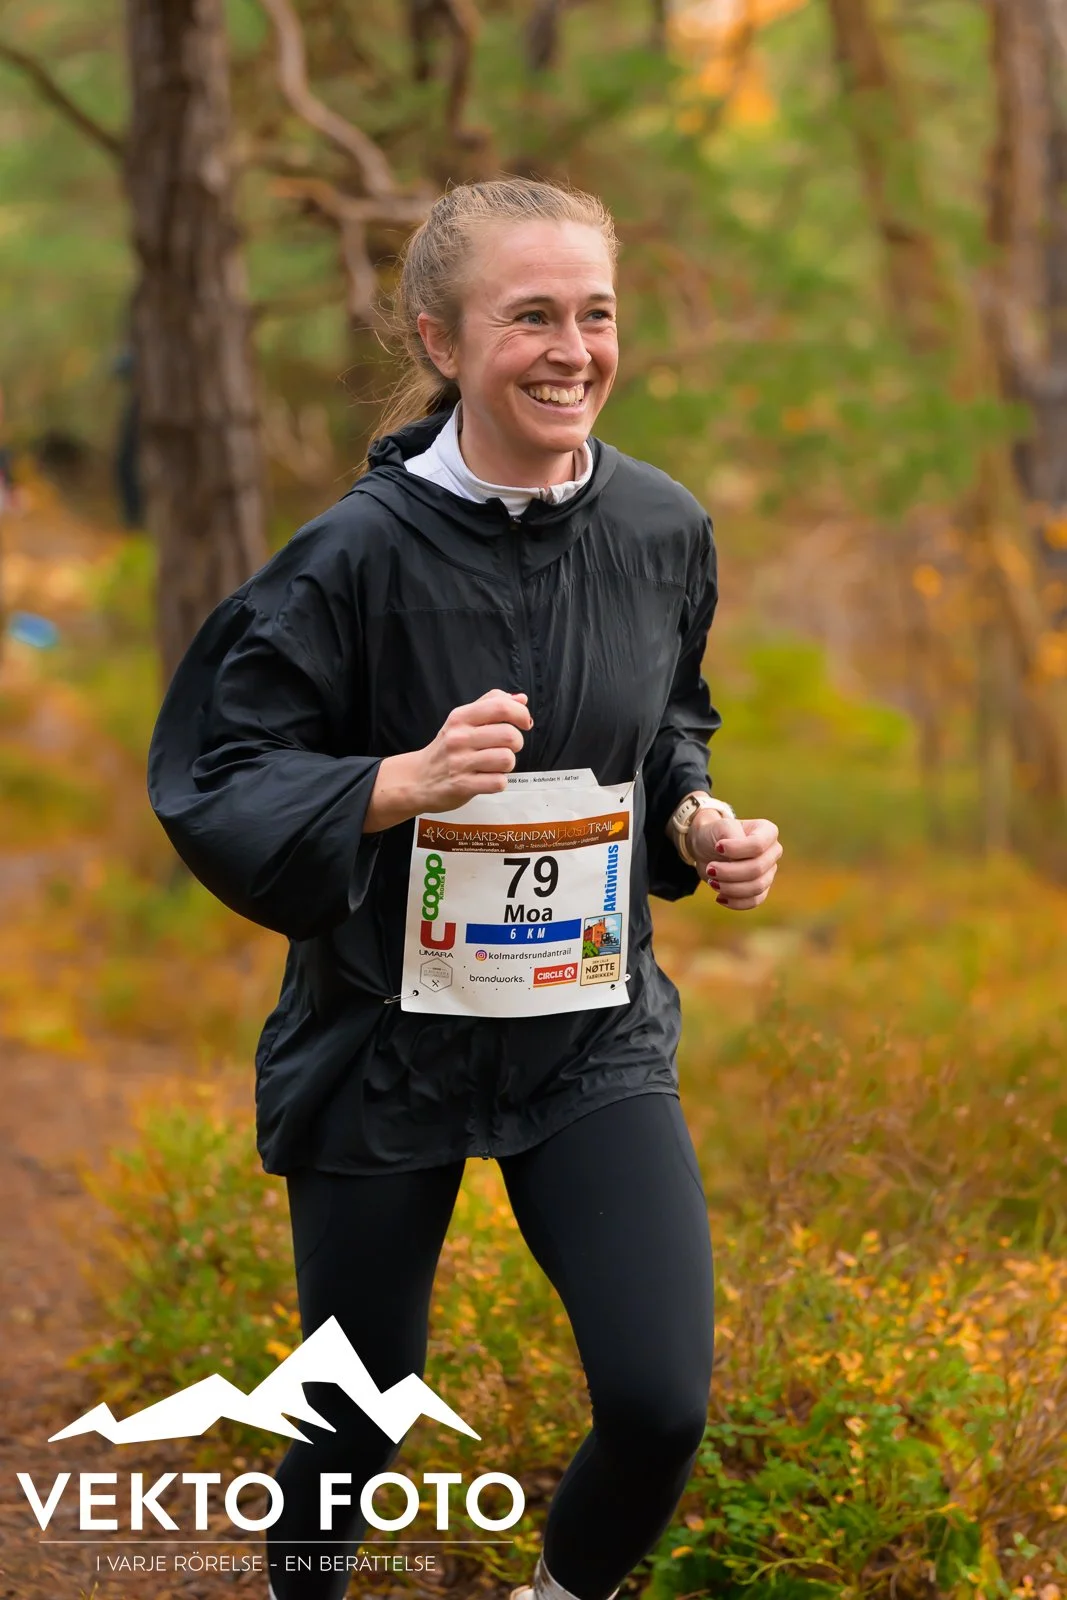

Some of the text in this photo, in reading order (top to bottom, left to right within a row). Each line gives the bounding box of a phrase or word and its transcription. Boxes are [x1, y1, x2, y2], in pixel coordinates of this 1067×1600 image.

[503, 855, 559, 898] 79
[603, 844, 619, 912] Aktivitus
[421, 853, 446, 921] coop
[503, 904, 553, 923] Moa
[510, 928, 517, 940] 6
[418, 949, 454, 959] UMARA
[488, 948, 572, 961] kolmardsrundantrail
[537, 967, 575, 981] CIRCLE K
[585, 962, 615, 975] NØTTE
